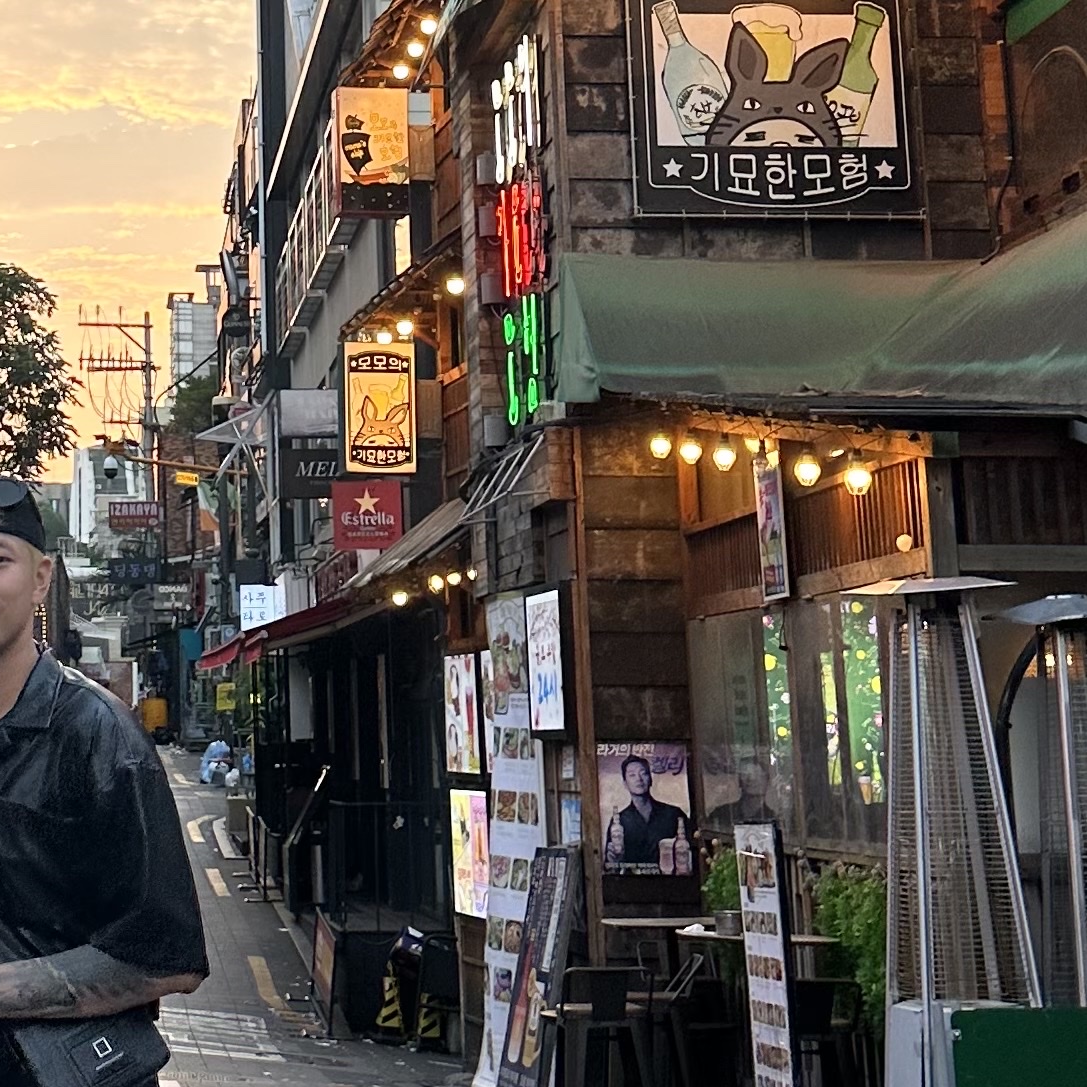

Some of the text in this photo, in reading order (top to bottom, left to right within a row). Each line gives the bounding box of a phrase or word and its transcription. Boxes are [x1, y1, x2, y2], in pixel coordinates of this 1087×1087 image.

[691, 153, 868, 200] 기묘한모험
[358, 356, 402, 371] 모모의
[110, 503, 158, 516] IZAKAYA
[341, 511, 394, 526] Estrella
[243, 591, 266, 605] 사주
[597, 743, 630, 756] 라거의
